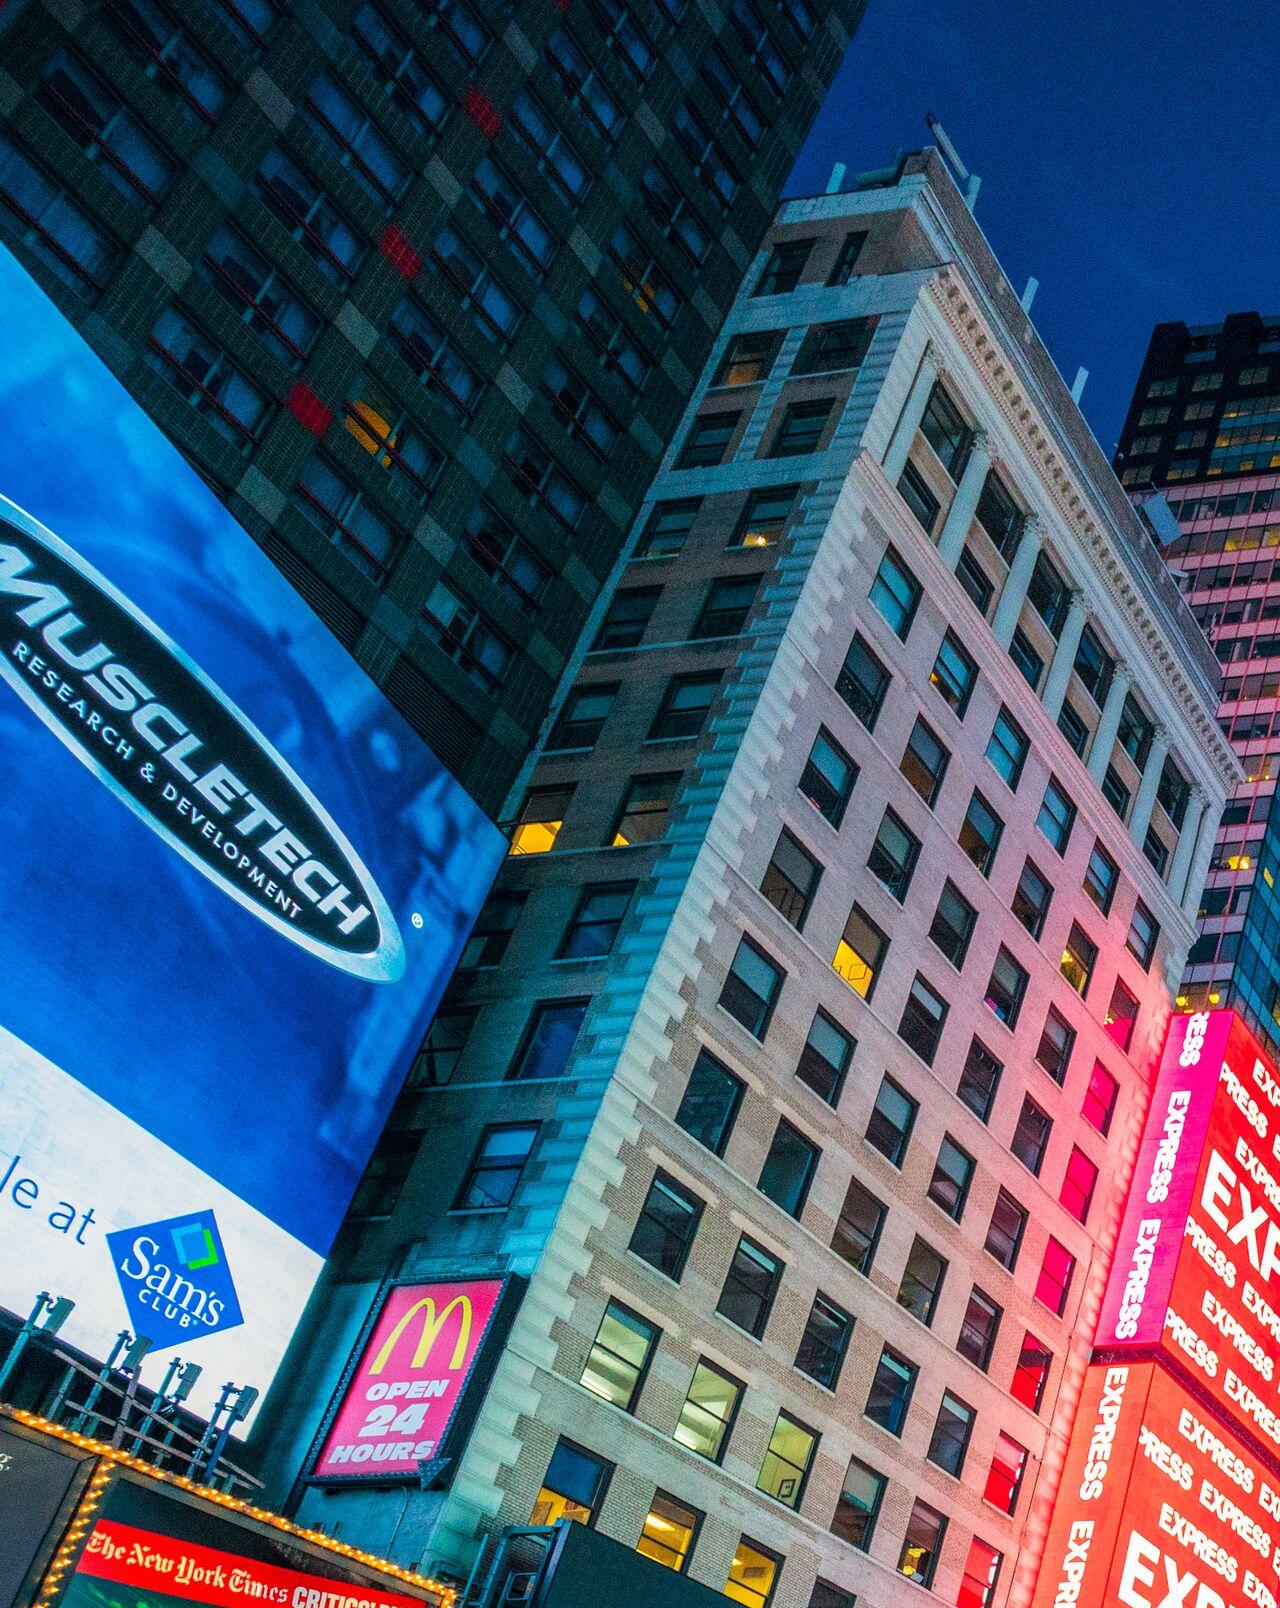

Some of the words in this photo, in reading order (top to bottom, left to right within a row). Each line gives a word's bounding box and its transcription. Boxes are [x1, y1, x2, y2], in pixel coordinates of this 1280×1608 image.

[0, 543, 371, 936] MUSCLETECH
[12, 641, 134, 762] RESEARCH
[162, 784, 302, 920] DEVELOPMENT
[1146, 1089, 1192, 1205] EXPRESS
[49, 1200, 96, 1246] at
[121, 1236, 227, 1328] Sam's
[138, 1288, 194, 1330] CLUB
[1201, 1289, 1275, 1383] EXPRESS
[357, 1403, 428, 1437] 24
[365, 1378, 450, 1402] OPEN
[328, 1439, 437, 1466] HOURS
[1078, 1366, 1129, 1502] EXPRESS
[1177, 1407, 1256, 1495] EXPRESS
[86, 1532, 127, 1562] The
[126, 1543, 172, 1575] New
[176, 1556, 228, 1590] York
[228, 1568, 289, 1604] Times
[1157, 1501, 1239, 1584] EXPRESS
